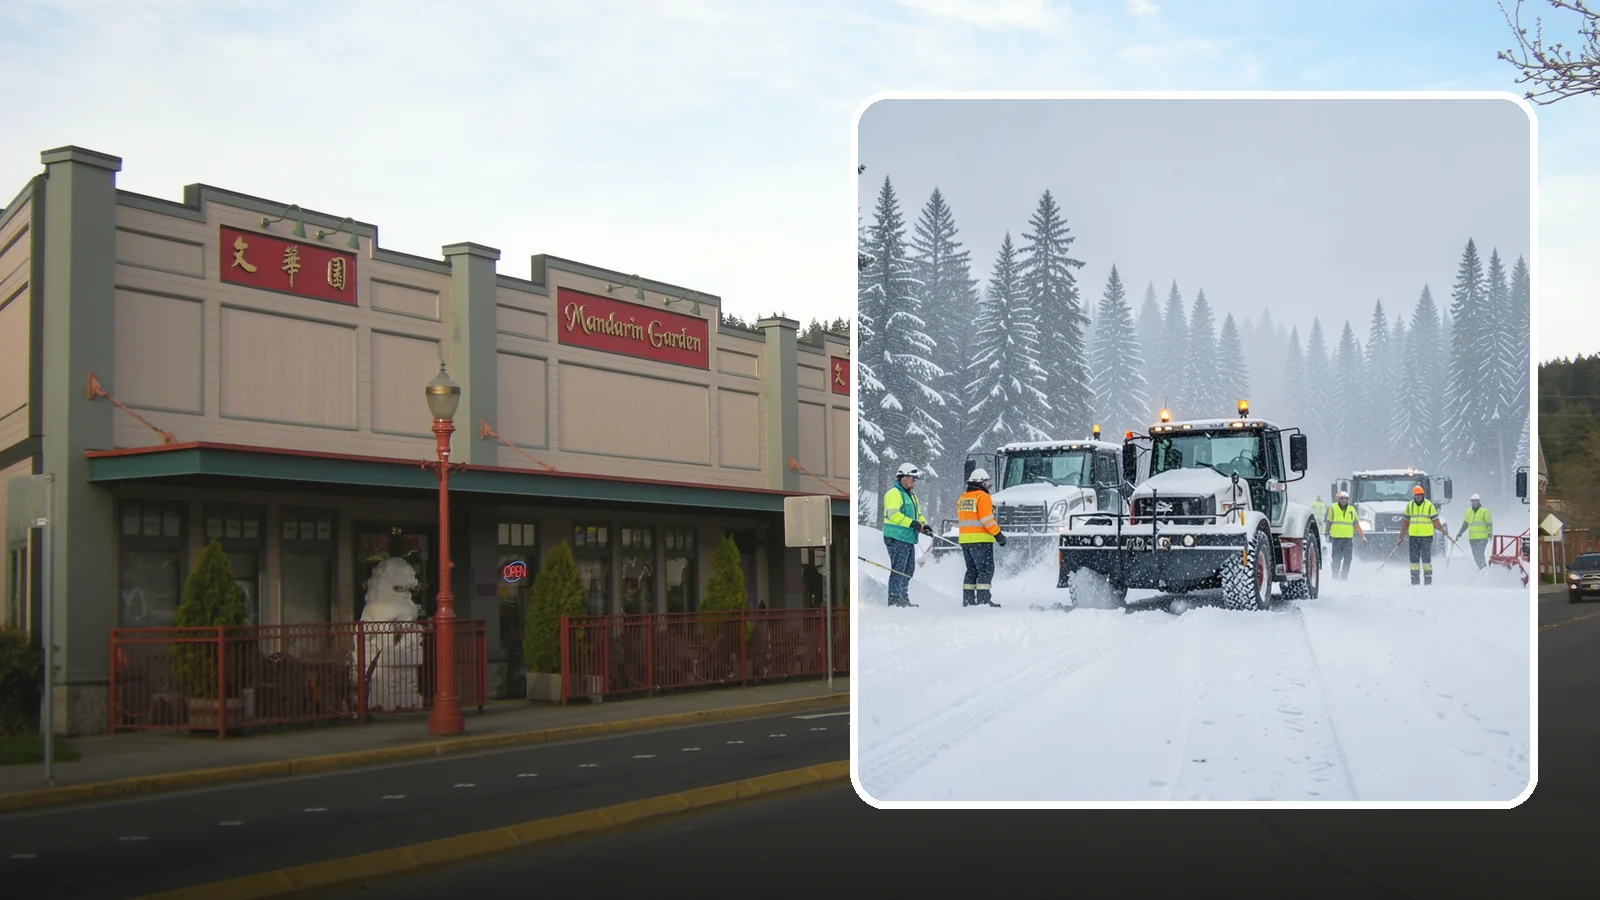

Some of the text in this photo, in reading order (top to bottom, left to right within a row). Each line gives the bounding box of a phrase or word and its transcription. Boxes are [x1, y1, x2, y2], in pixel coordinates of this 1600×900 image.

[231, 236, 346, 291] 文華園
[564, 302, 701, 352] Mandarin Garden
[503, 565, 527, 578] OPEN
